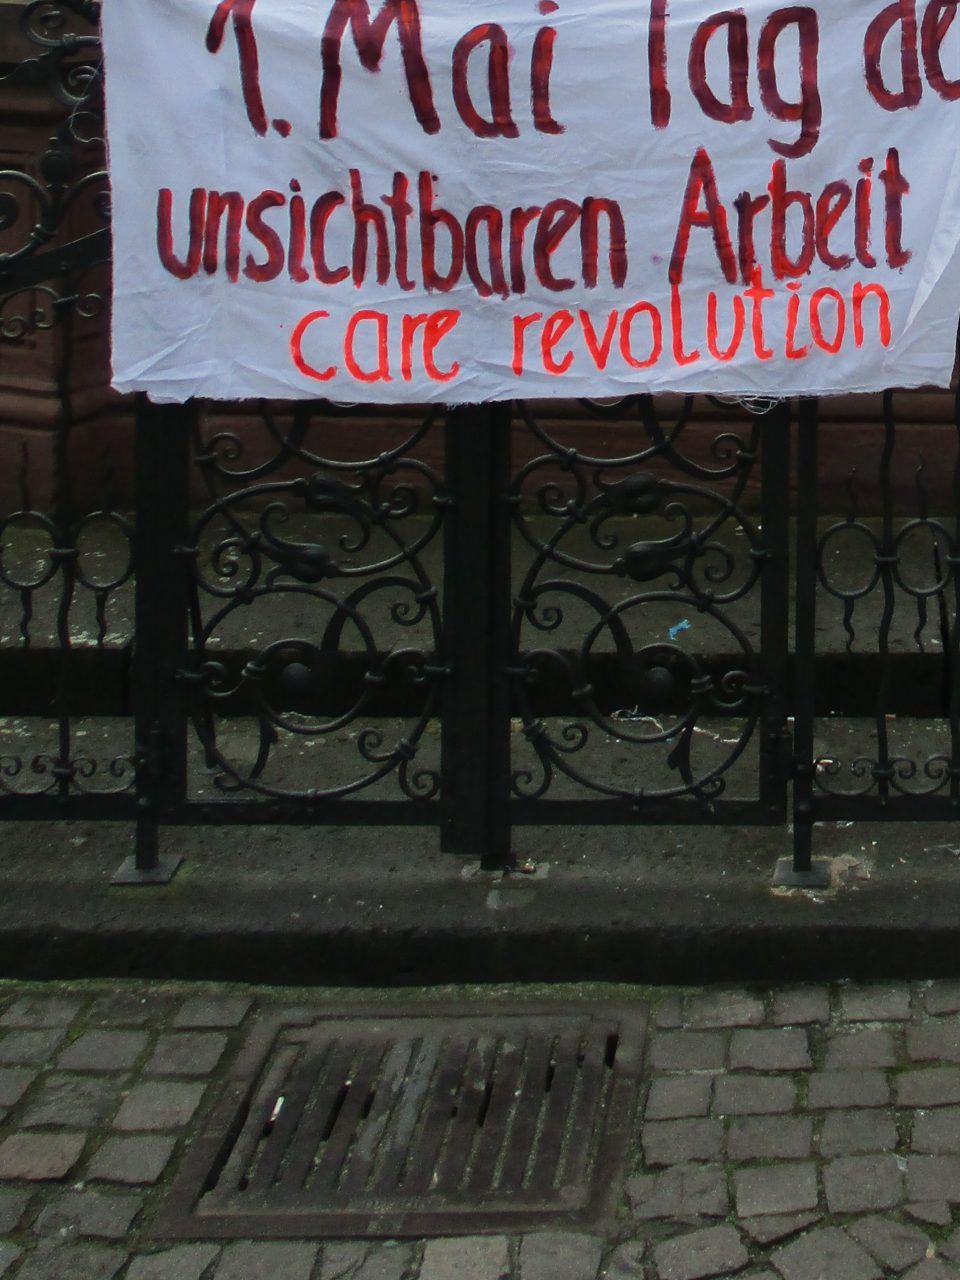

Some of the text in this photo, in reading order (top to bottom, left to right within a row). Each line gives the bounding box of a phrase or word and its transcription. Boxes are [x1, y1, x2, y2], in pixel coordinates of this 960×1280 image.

[157, 146, 912, 299] unsichtbaren Arbeit
[288, 264, 892, 383] care revolution
